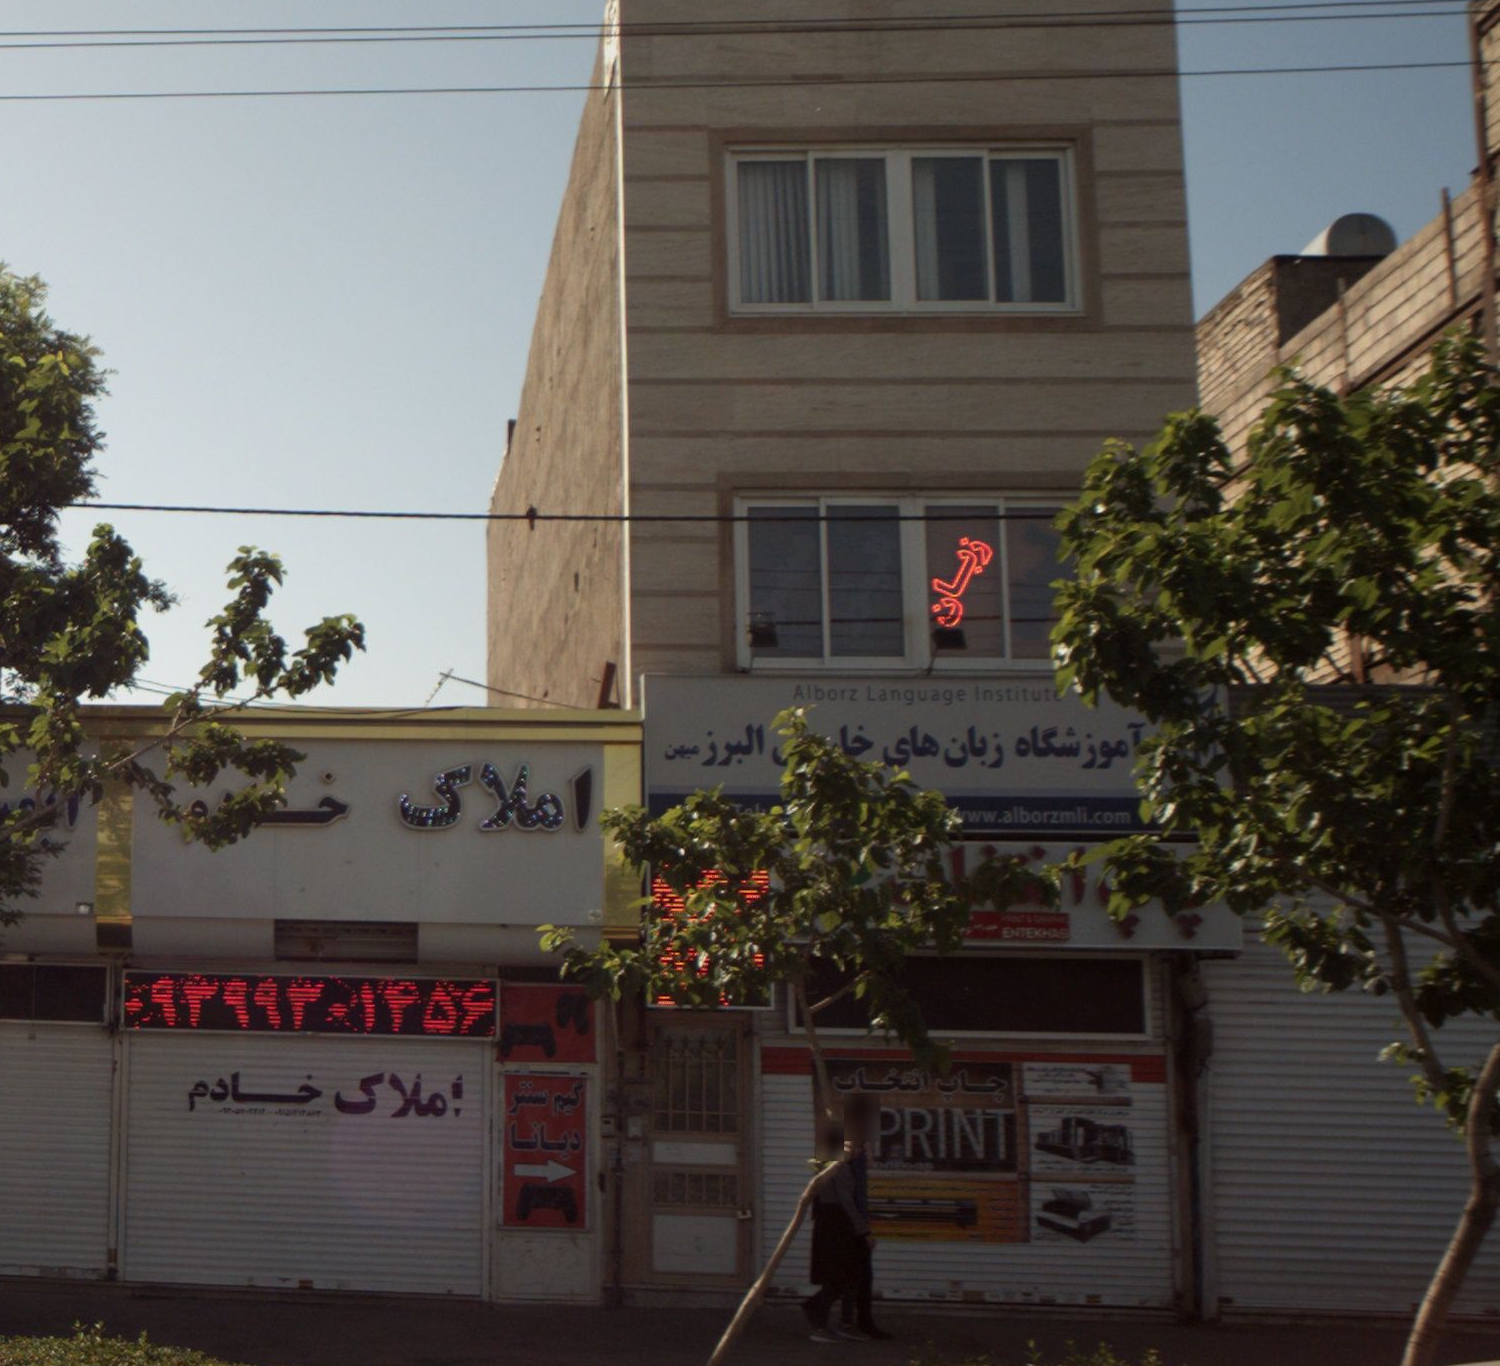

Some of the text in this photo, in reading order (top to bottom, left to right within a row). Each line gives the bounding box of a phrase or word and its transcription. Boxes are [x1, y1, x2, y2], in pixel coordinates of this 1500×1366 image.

[793, 685, 857, 701] Alborz
[867, 685, 966, 706] Language
[701, 723, 765, 767] البرز
[945, 725, 1003, 769] زبان
[1016, 722, 1146, 768] آموزشگاه
[398, 760, 594, 834] املاک
[188, 1072, 464, 1118] املاک خادم
[833, 1067, 931, 1093] انتخاب
[935, 1068, 1009, 1103] چاپ
[874, 1106, 1015, 1160] PRINT
